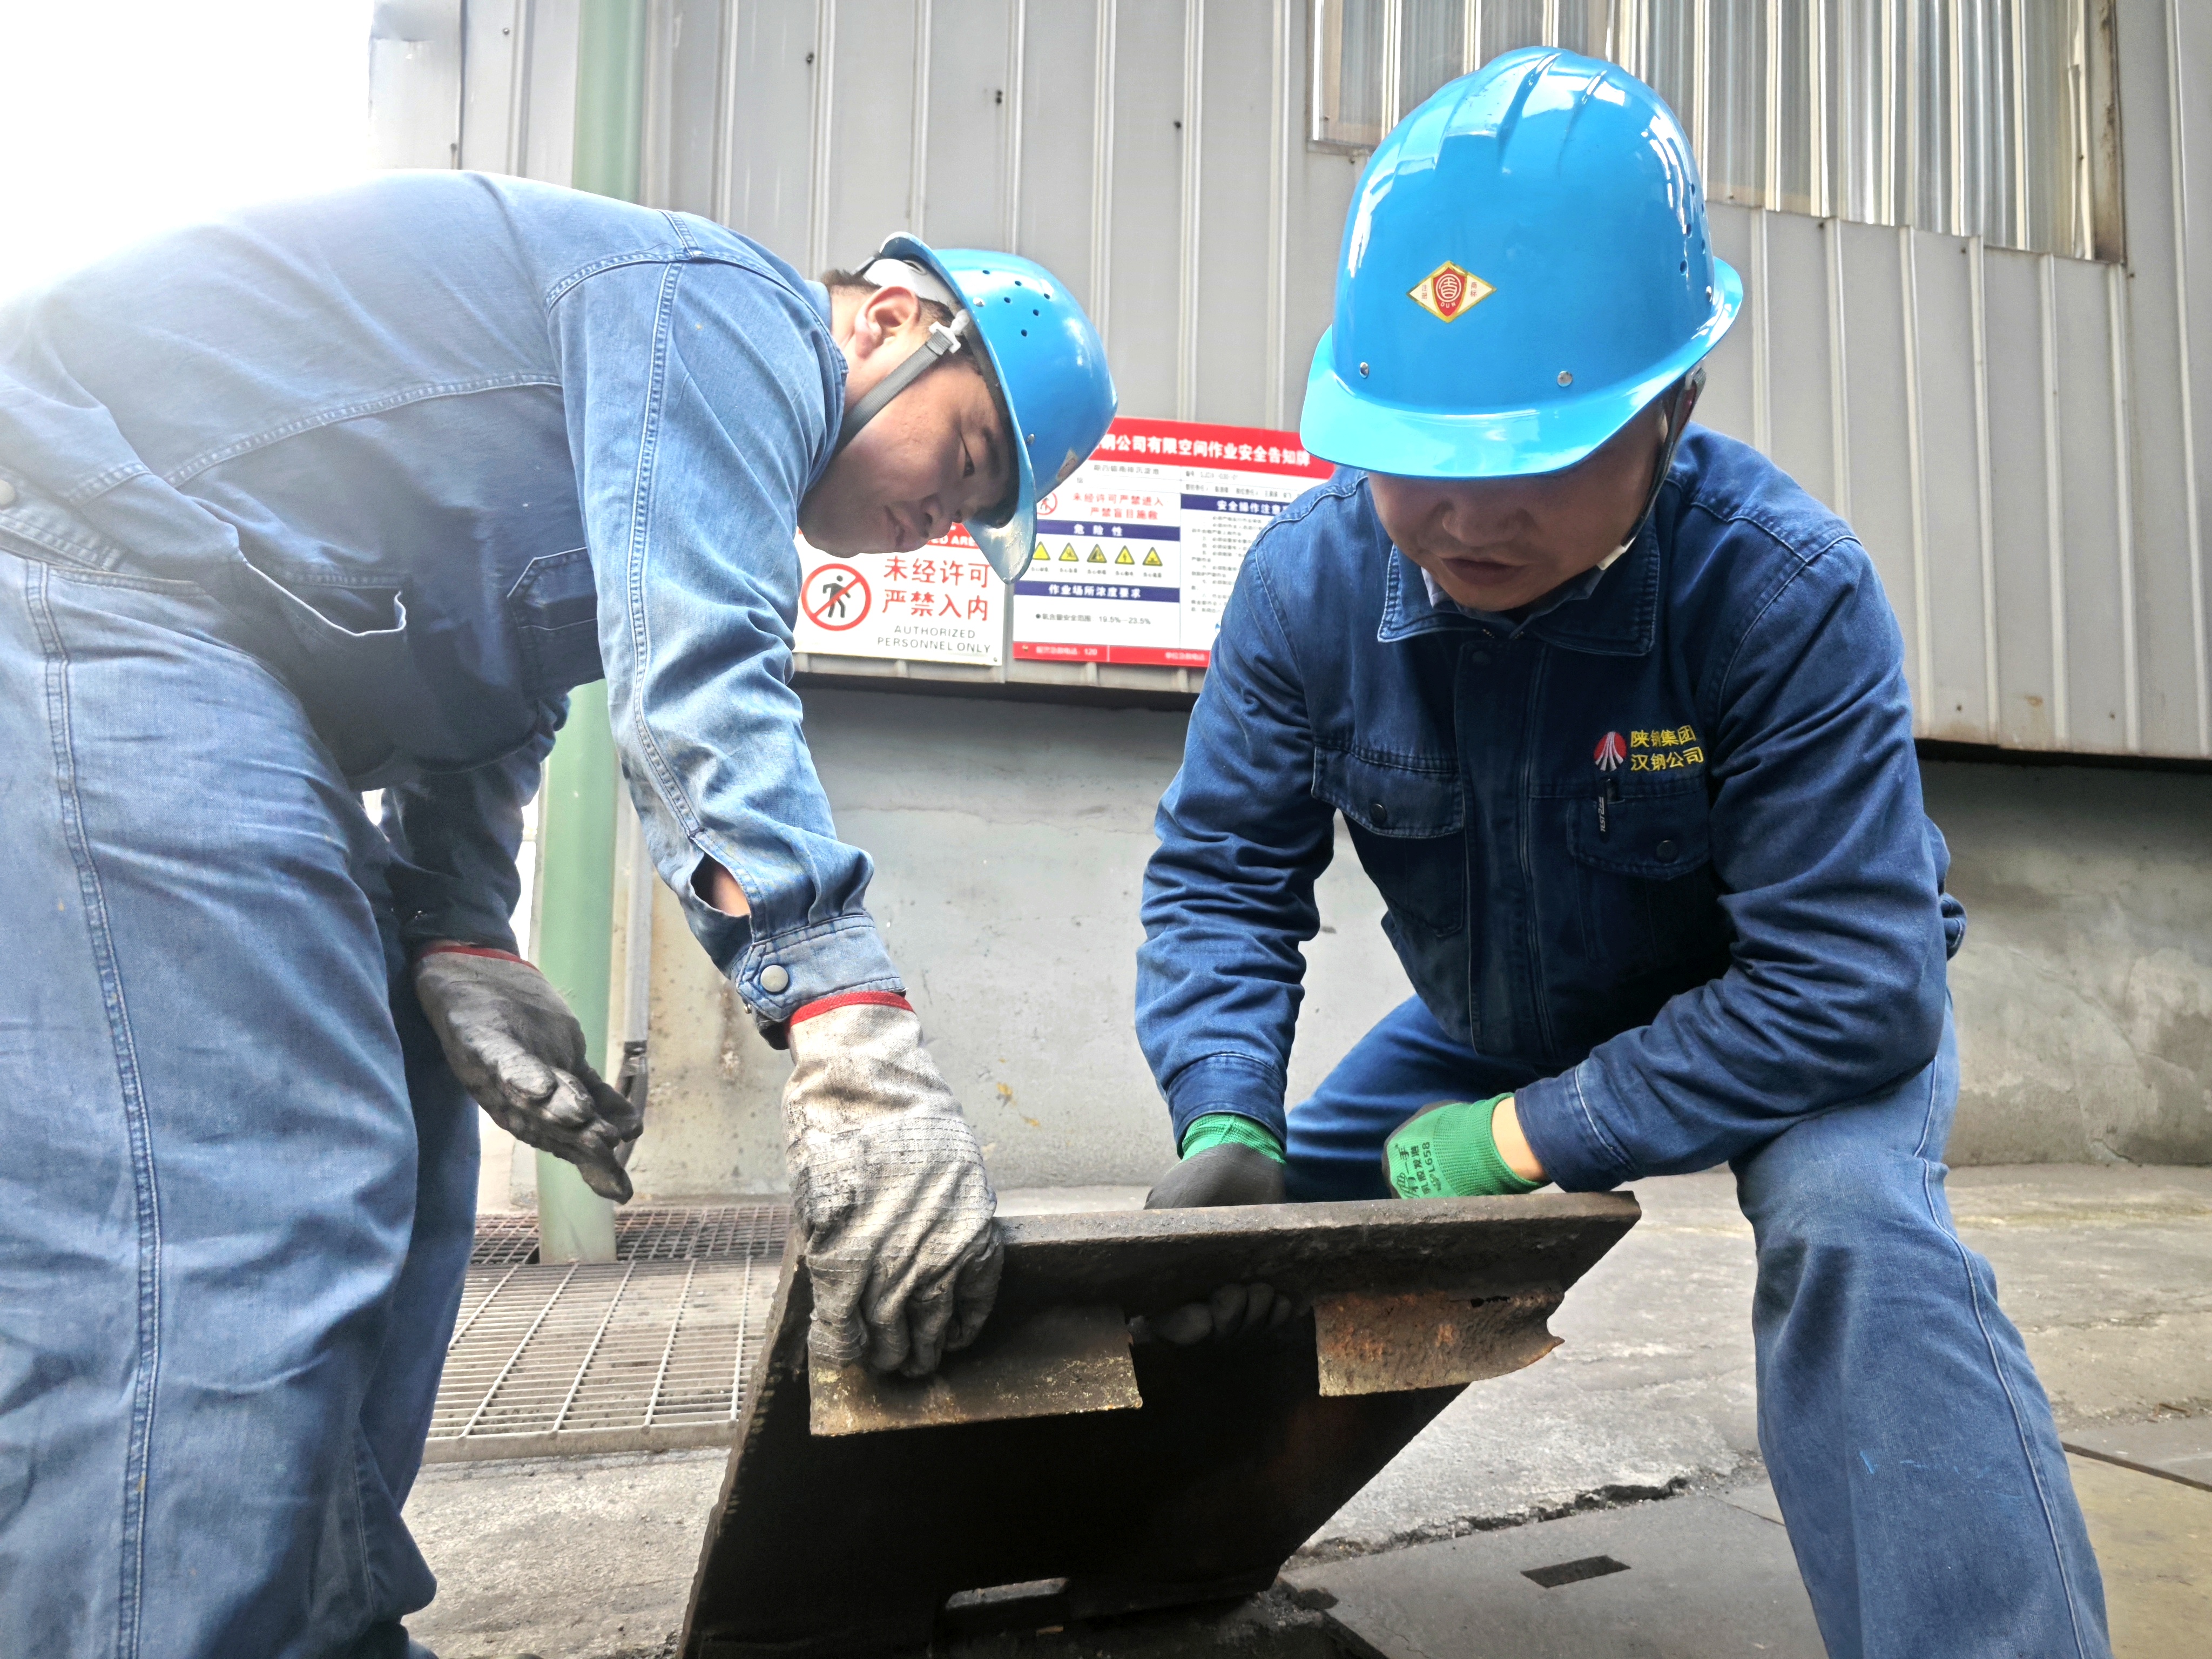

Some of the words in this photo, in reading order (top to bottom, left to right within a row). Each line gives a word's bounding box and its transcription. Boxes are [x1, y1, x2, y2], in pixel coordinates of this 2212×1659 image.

[1470, 282, 1478, 298] 商标
[1096, 434, 1311, 467] 钢公司有限空间作业安全告知牌
[1073, 493, 1164, 507] 未经许可严禁进入
[884, 555, 991, 588] 未经许可
[1049, 584, 1141, 599] 作业场所浓度要求
[882, 589, 988, 621] 严禁入内
[894, 625, 975, 639] AUTHORIZED
[878, 637, 953, 651] PERSONNEL
[957, 642, 991, 653] ONLY
[1084, 648, 1098, 656] 120
[1630, 725, 1697, 748] 陕钢集团
[1630, 746, 1704, 771] 汉钢公司
[1422, 1142, 1435, 1173] L658
[1411, 1145, 1431, 1195] 乳胶发泡
